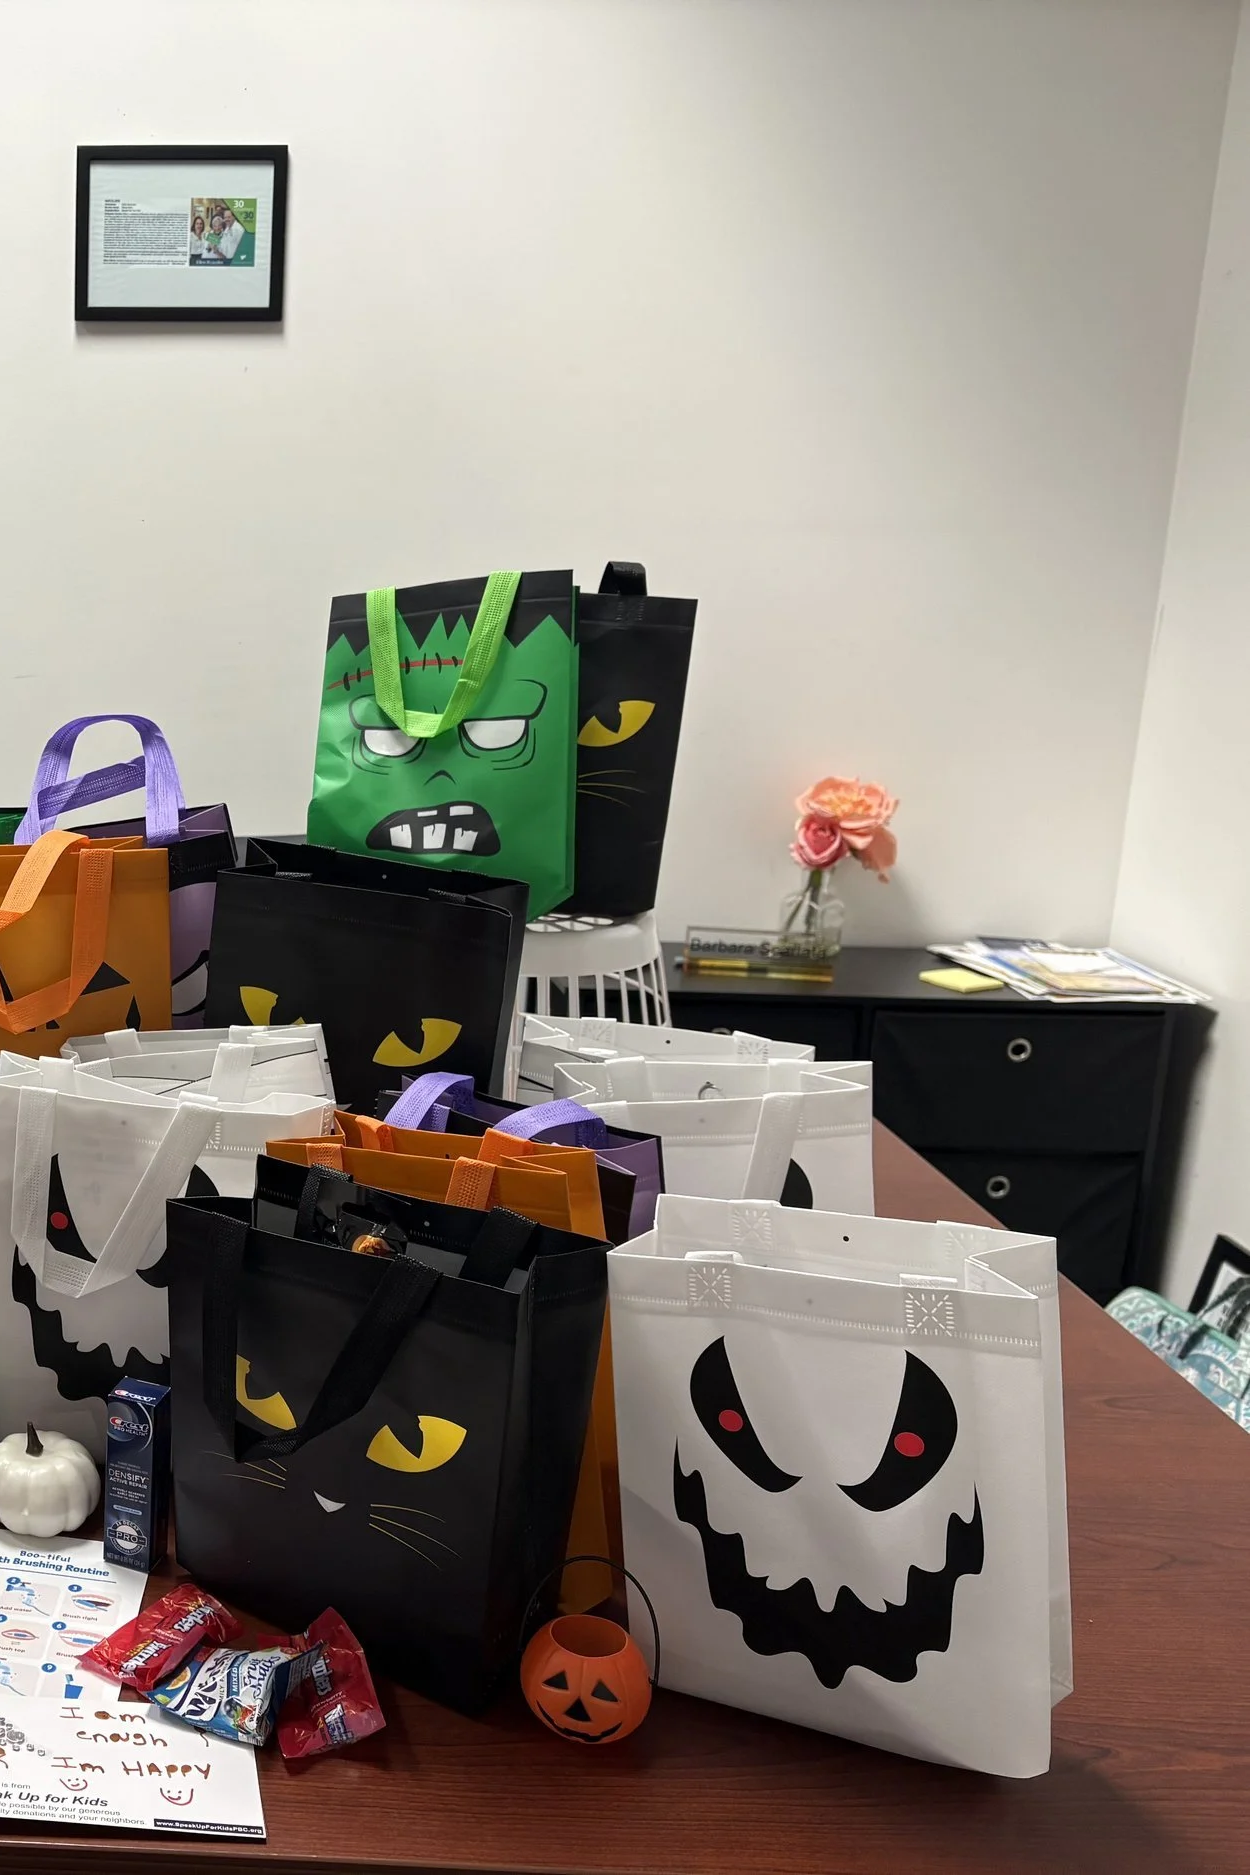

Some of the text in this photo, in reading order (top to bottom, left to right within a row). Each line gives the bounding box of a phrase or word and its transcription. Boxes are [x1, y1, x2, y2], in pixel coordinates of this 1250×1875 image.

[233, 200, 245, 208] 30
[690, 938, 755, 954] Barbara
[110, 1416, 149, 1433] Crest
[108, 1468, 146, 1484] DENSIFY
[110, 1477, 148, 1490] ACTIVE REPAIR
[123, 1520, 140, 1531] DECAY
[116, 1531, 138, 1543] PRO
[20, 1550, 71, 1563] Boo-tiful
[12, 1557, 64, 1572] Brushing
[65, 1564, 110, 1577] Routine
[82, 1614, 98, 1622] right
[155, 1628, 184, 1641] strawberry
[119, 1640, 172, 1679] Twizzlers
[243, 1658, 260, 1688] Fruit
[253, 1656, 281, 1698] Snacks
[59, 1706, 146, 1724] I am
[122, 1761, 211, 1780] HAPPY
[11, 1782, 31, 1790] from
[18, 1792, 40, 1804] Up
[45, 1794, 68, 1804] for
[72, 1796, 109, 1807] Kids
[9, 1802, 46, 1811] possible
[78, 1808, 121, 1816] generous
[12, 1809, 57, 1818] donations
[58, 1812, 76, 1820] and
[78, 1814, 97, 1822] your
[100, 1816, 147, 1825] neighbors.
[156, 1820, 262, 1834] www.SpeakUpForKidsPBC.org
